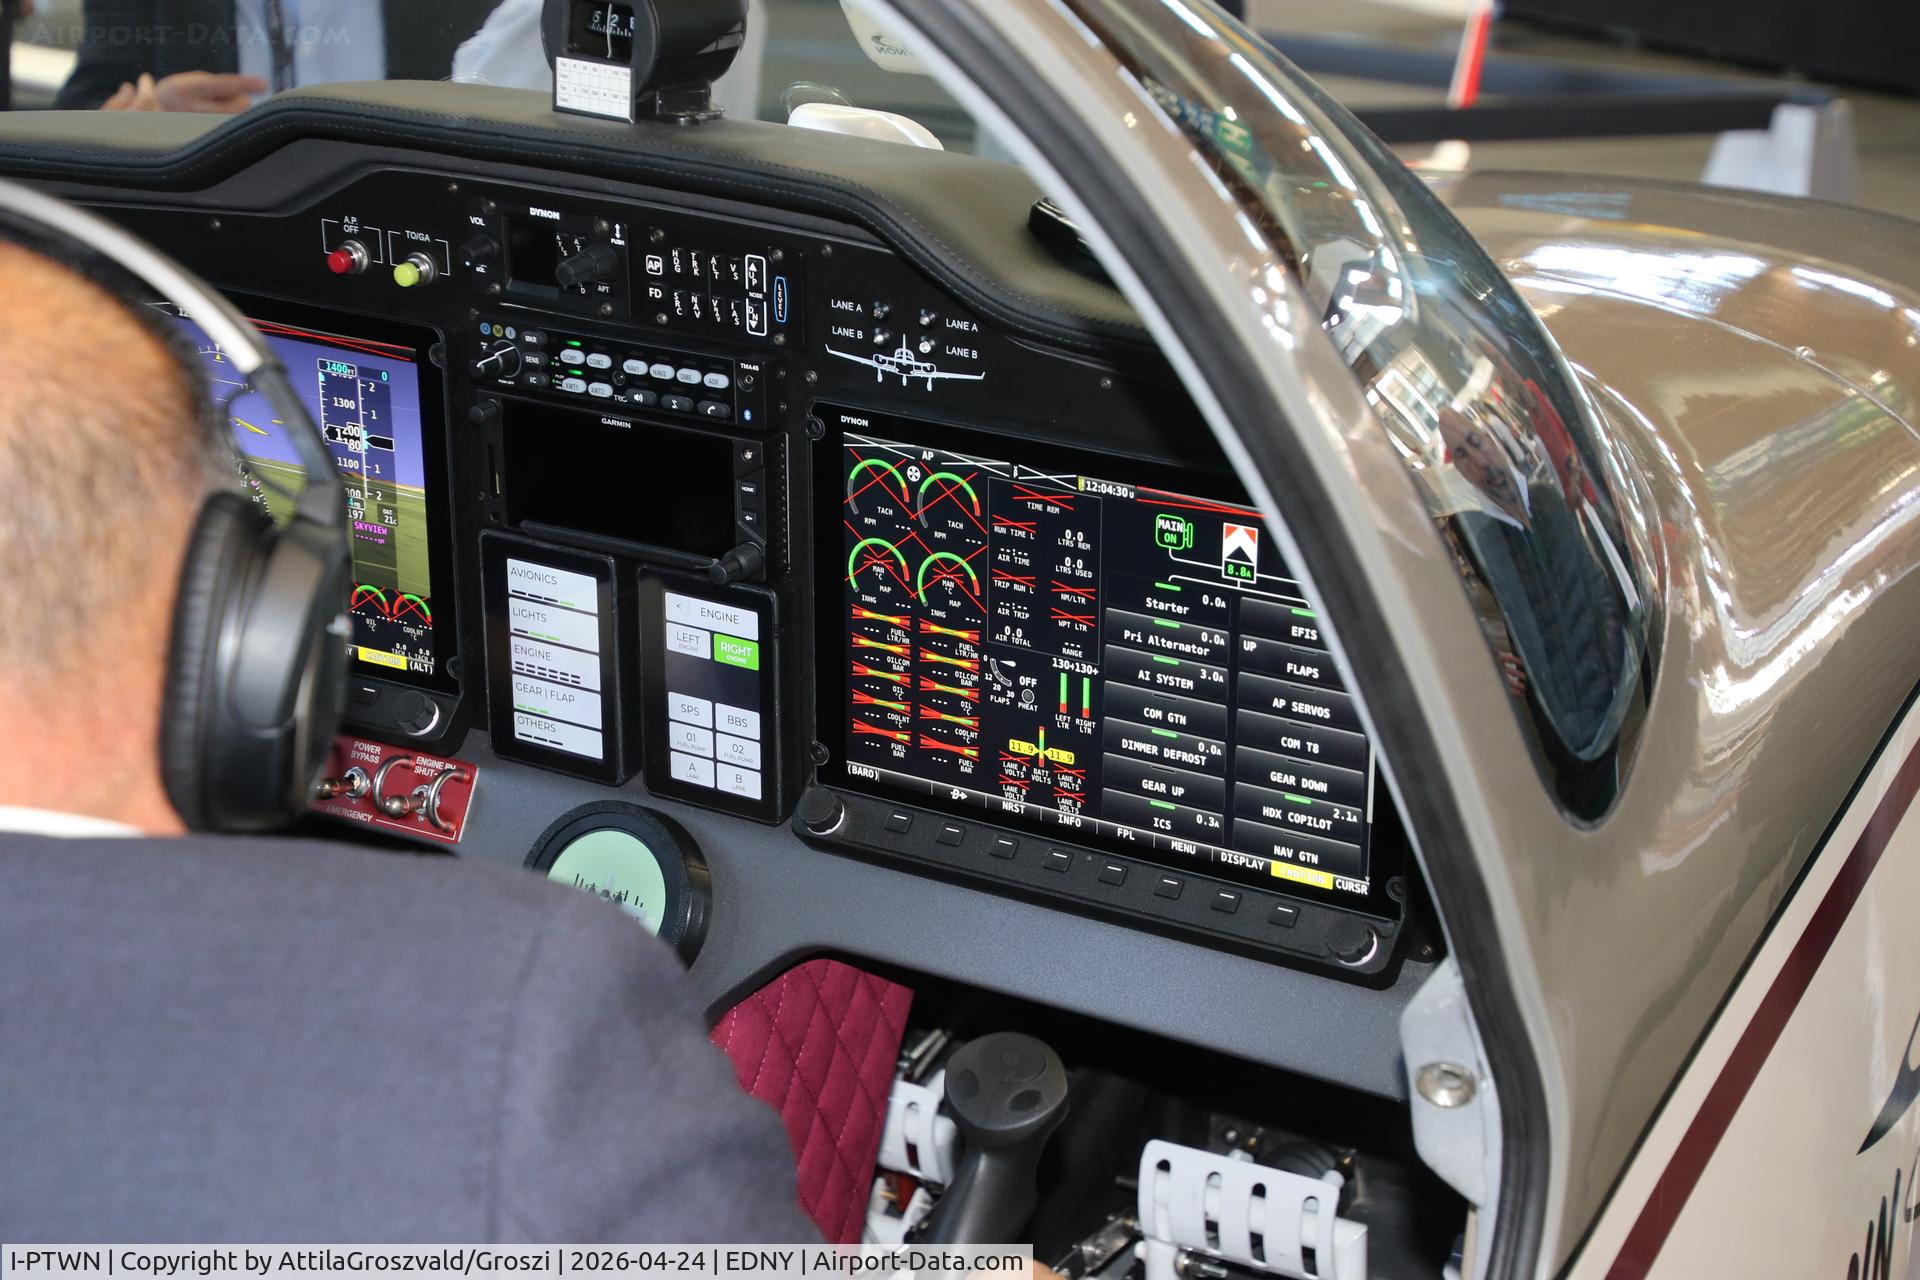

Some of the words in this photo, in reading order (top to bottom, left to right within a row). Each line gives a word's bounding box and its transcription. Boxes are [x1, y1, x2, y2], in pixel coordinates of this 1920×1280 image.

[343, 215, 358, 225] A.P.
[529, 207, 560, 220] DYNON
[469, 215, 486, 226] VOL
[343, 224, 359, 234] OFF
[405, 230, 431, 243] TO/GA
[648, 260, 661, 271] AP
[672, 249, 681, 273] HDG
[691, 252, 700, 276] TRK
[710, 256, 720, 280] ALT
[649, 287, 662, 299] FD
[673, 292, 683, 315] SRC
[831, 299, 854, 311] LANE
[855, 304, 863, 313] A
[711, 299, 721, 323] VNAV
[731, 302, 740, 326] IAS
[945, 318, 969, 330] LANE
[971, 323, 978, 332] A
[832, 325, 854, 338] LANE
[857, 330, 863, 339] B
[946, 345, 969, 357] LANE
[971, 350, 978, 359] B
[333, 396, 355, 410] 1300
[601, 417, 631, 429] GARMIN
[840, 415, 869, 427] DYNON
[921, 450, 934, 461] AP
[337, 456, 359, 469] 1100
[877, 506, 893, 516] TACH
[1026, 501, 1043, 512] TIME
[1046, 504, 1060, 514] REM
[864, 516, 877, 526] RPM
[947, 520, 964, 530] TACH
[1158, 519, 1183, 533] MAIN
[354, 521, 388, 535] SKYVIEW
[934, 530, 947, 540] RPM
[1065, 529, 1084, 542] 0.0
[1164, 533, 1177, 544] ON
[1057, 538, 1074, 549] LTRS
[1076, 540, 1091, 550] REM
[997, 553, 1011, 563] AIR
[1013, 556, 1030, 566] TIME
[1064, 556, 1083, 569] 0.0
[510, 566, 558, 586] AVIONICS
[1055, 565, 1072, 576] LTRS
[1075, 568, 1093, 579] USED
[949, 599, 961, 608] MAP
[1146, 597, 1190, 615] Starter
[512, 606, 547, 623] LIGHTS
[700, 607, 739, 625] ENGINE
[997, 607, 1011, 617] AIR
[1013, 609, 1030, 620] TRIP
[1004, 625, 1023, 638] 0.0
[1058, 619, 1071, 629] WPT
[1074, 622, 1087, 632] LTR
[676, 631, 701, 645] LEFT
[890, 628, 906, 638] FUEL
[1291, 626, 1318, 640] EFIS
[995, 633, 1009, 643] AIR
[1011, 635, 1031, 647] TOTAL
[1124, 630, 1142, 643] Pri
[1147, 635, 1210, 657] Alternator
[1243, 640, 1257, 652] UP
[514, 644, 552, 662] ENGINE
[720, 641, 753, 657] RIGHT
[958, 642, 975, 652] FUEL
[1062, 646, 1083, 658] RANGE
[725, 654, 747, 665] ENGINE
[409, 661, 433, 675] (ALT)
[892, 663, 905, 672] BAR
[1287, 663, 1320, 678] FLAPS
[960, 677, 973, 687] BAR
[1019, 675, 1037, 687] OFF
[1138, 670, 1151, 682] AI
[1156, 673, 1194, 690] SYSTEM
[515, 682, 543, 696] GEAR
[550, 690, 575, 703] FLAP
[892, 685, 905, 695] OIL
[960, 700, 973, 710] OIL
[990, 694, 1010, 706] FLAPS
[1018, 701, 1038, 712] PHEAT
[680, 704, 700, 717] SPS
[1272, 698, 1286, 709] AP
[1291, 702, 1331, 719] SERVOS
[727, 714, 748, 728] BBS
[887, 713, 910, 724] COOLNT
[1055, 713, 1071, 723] LEFT
[1143, 707, 1162, 721] COM
[1167, 712, 1187, 725] GTN
[517, 715, 557, 733] OTHERS
[1057, 720, 1070, 730] LTR
[1075, 718, 1096, 729] RIGHT
[1079, 725, 1092, 735] LTR
[686, 732, 696, 743] 01
[954, 728, 979, 739] COOLNT
[353, 741, 381, 755] POWER
[732, 743, 744, 755] 02
[891, 743, 906, 753] FUEL
[1010, 740, 1034, 753] 11.9
[1281, 736, 1301, 750] COM
[1305, 742, 1320, 754] T8
[351, 750, 380, 764] BYPASS
[892, 749, 905, 758] BAR
[1049, 750, 1073, 763] 11.9
[1121, 738, 1158, 755] DIMMER
[1163, 748, 1207, 766] DEFROST
[416, 756, 444, 769] ENGINE
[688, 762, 697, 773] A
[958, 758, 974, 768] FUEL
[960, 764, 973, 774] BAR
[735, 773, 743, 784] B
[847, 765, 879, 781] (BARO)
[1004, 768, 1025, 779] VOLTS
[1031, 773, 1052, 785] VOLTS
[1033, 768, 1049, 777] BATT
[1059, 780, 1080, 791] VOLTS
[1141, 779, 1166, 793] GEAR
[1171, 785, 1184, 797] UP
[1270, 771, 1296, 786] GEAR
[1301, 778, 1328, 793] DOWN
[1004, 791, 1025, 802] VOLTS
[326, 806, 374, 822] EMERGENCY
[1002, 801, 1025, 814] NRST
[1059, 804, 1080, 815] VOLTS
[1057, 814, 1082, 827] INFO
[1153, 817, 1172, 830] ICS
[1262, 806, 1282, 819] HDX
[1287, 811, 1332, 831] COPILOT
[1117, 828, 1135, 841] FPL
[1171, 840, 1196, 855] MENU
[1274, 845, 1293, 859] NAV
[1299, 851, 1319, 864] GTN
[1220, 852, 1265, 871] DISPLAY
[1335, 878, 1368, 895] CURSR
